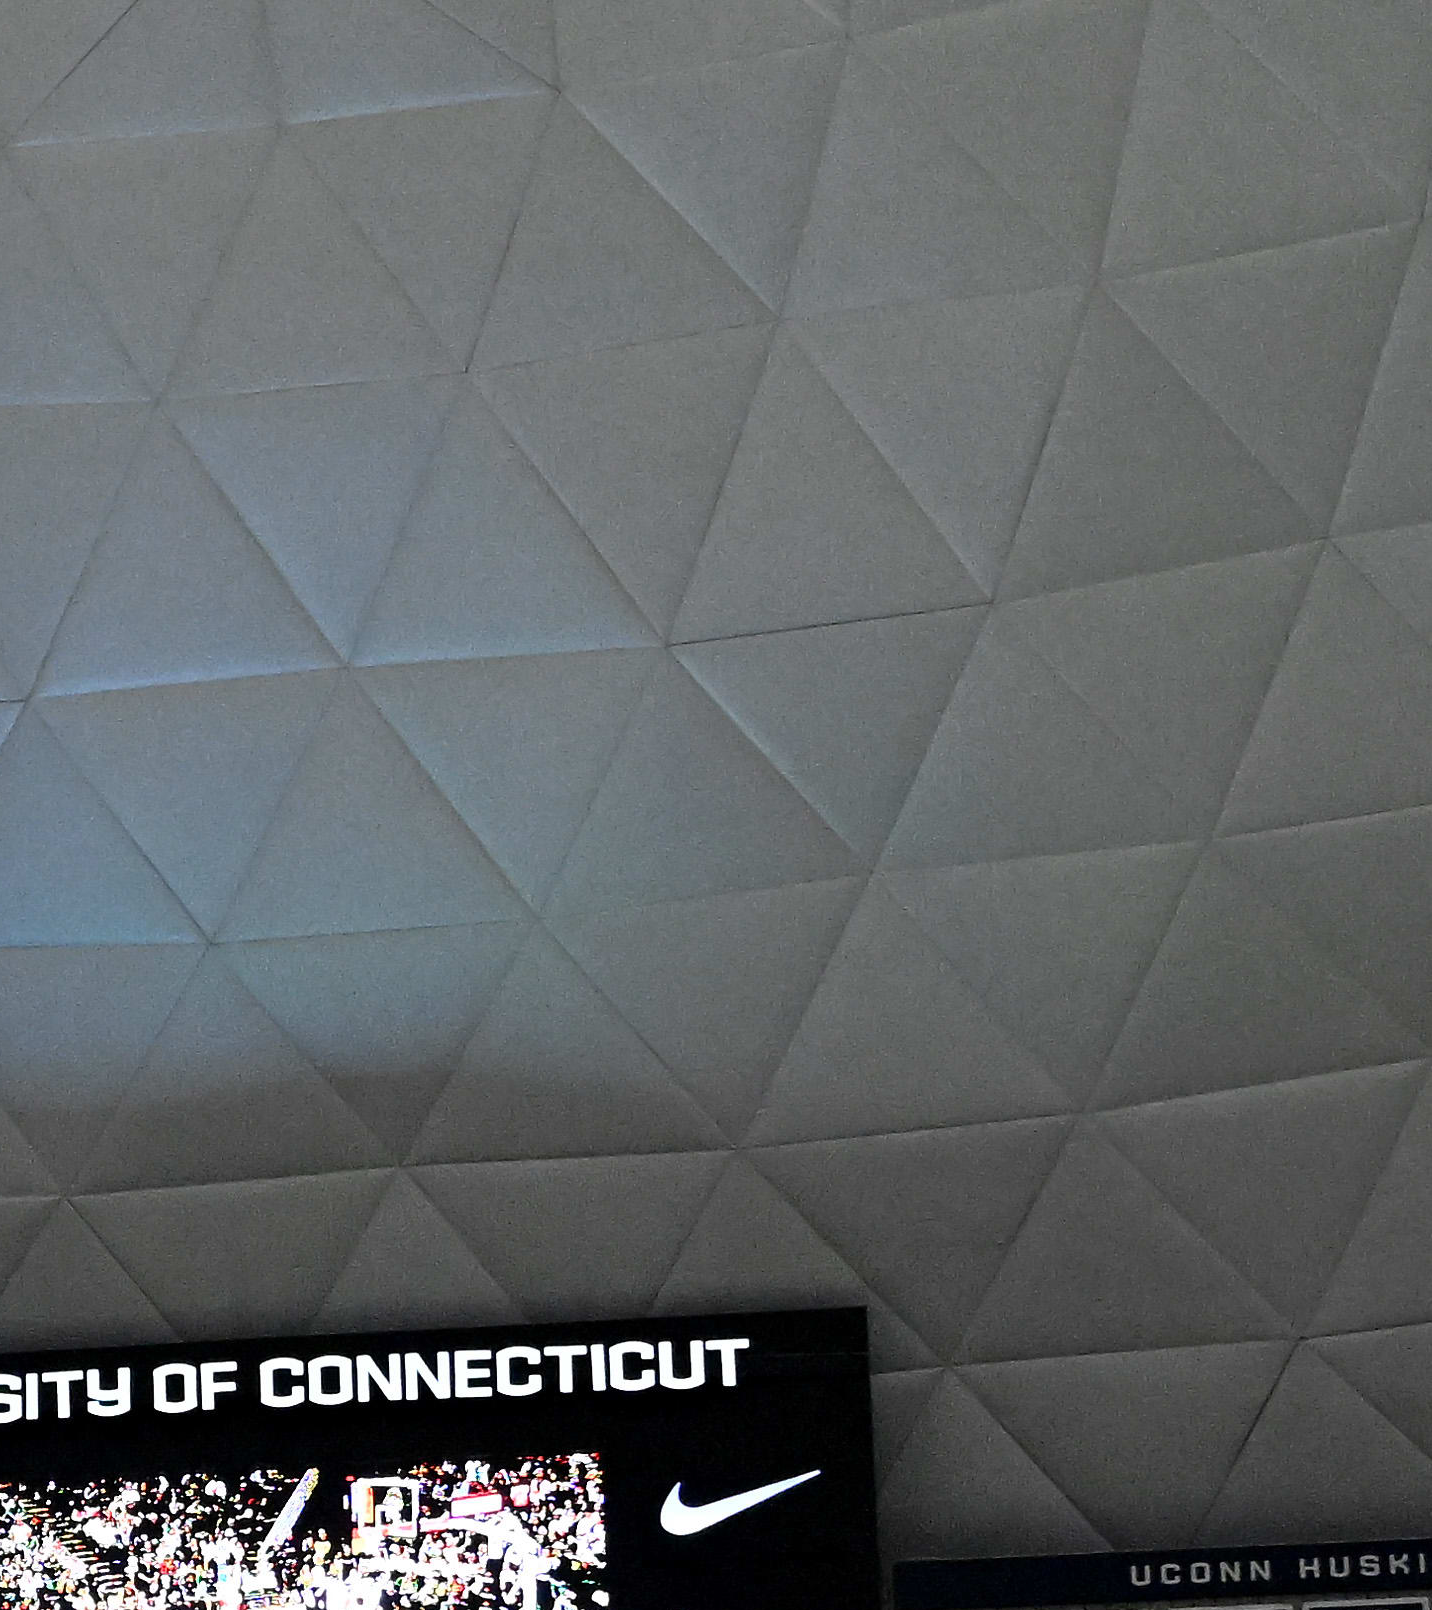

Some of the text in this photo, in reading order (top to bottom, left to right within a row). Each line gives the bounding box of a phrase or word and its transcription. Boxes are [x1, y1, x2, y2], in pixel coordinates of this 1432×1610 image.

[152, 1361, 238, 1414] OF
[259, 1337, 750, 1407] CONNECTICUT
[1130, 1559, 1272, 1586] UCONN
